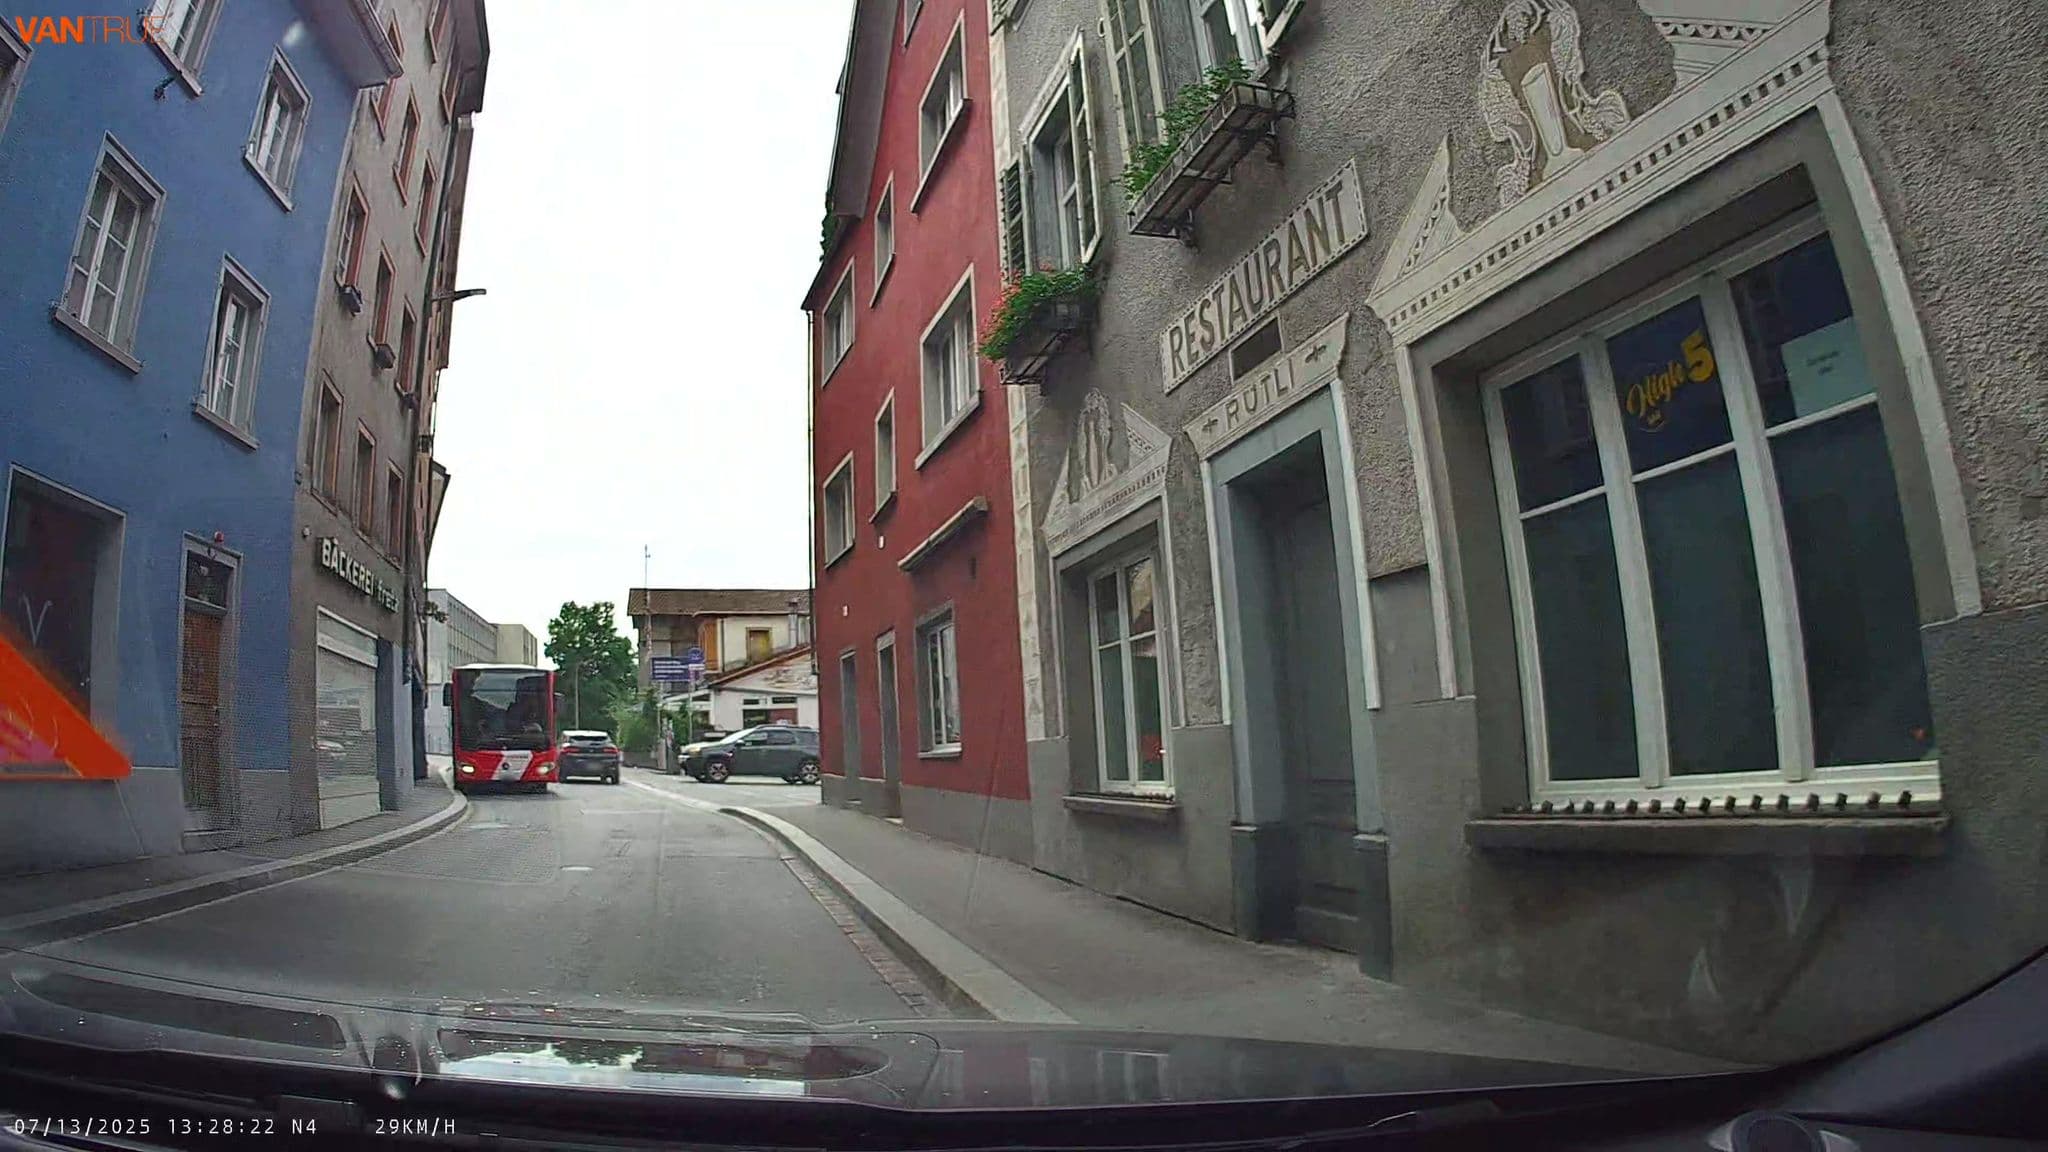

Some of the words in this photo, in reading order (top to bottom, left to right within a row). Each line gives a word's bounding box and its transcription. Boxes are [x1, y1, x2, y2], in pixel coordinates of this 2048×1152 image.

[1168, 182, 1346, 379] RESTAURANT
[1681, 328, 1715, 384] 5
[322, 538, 374, 596] BÄCKEREI
